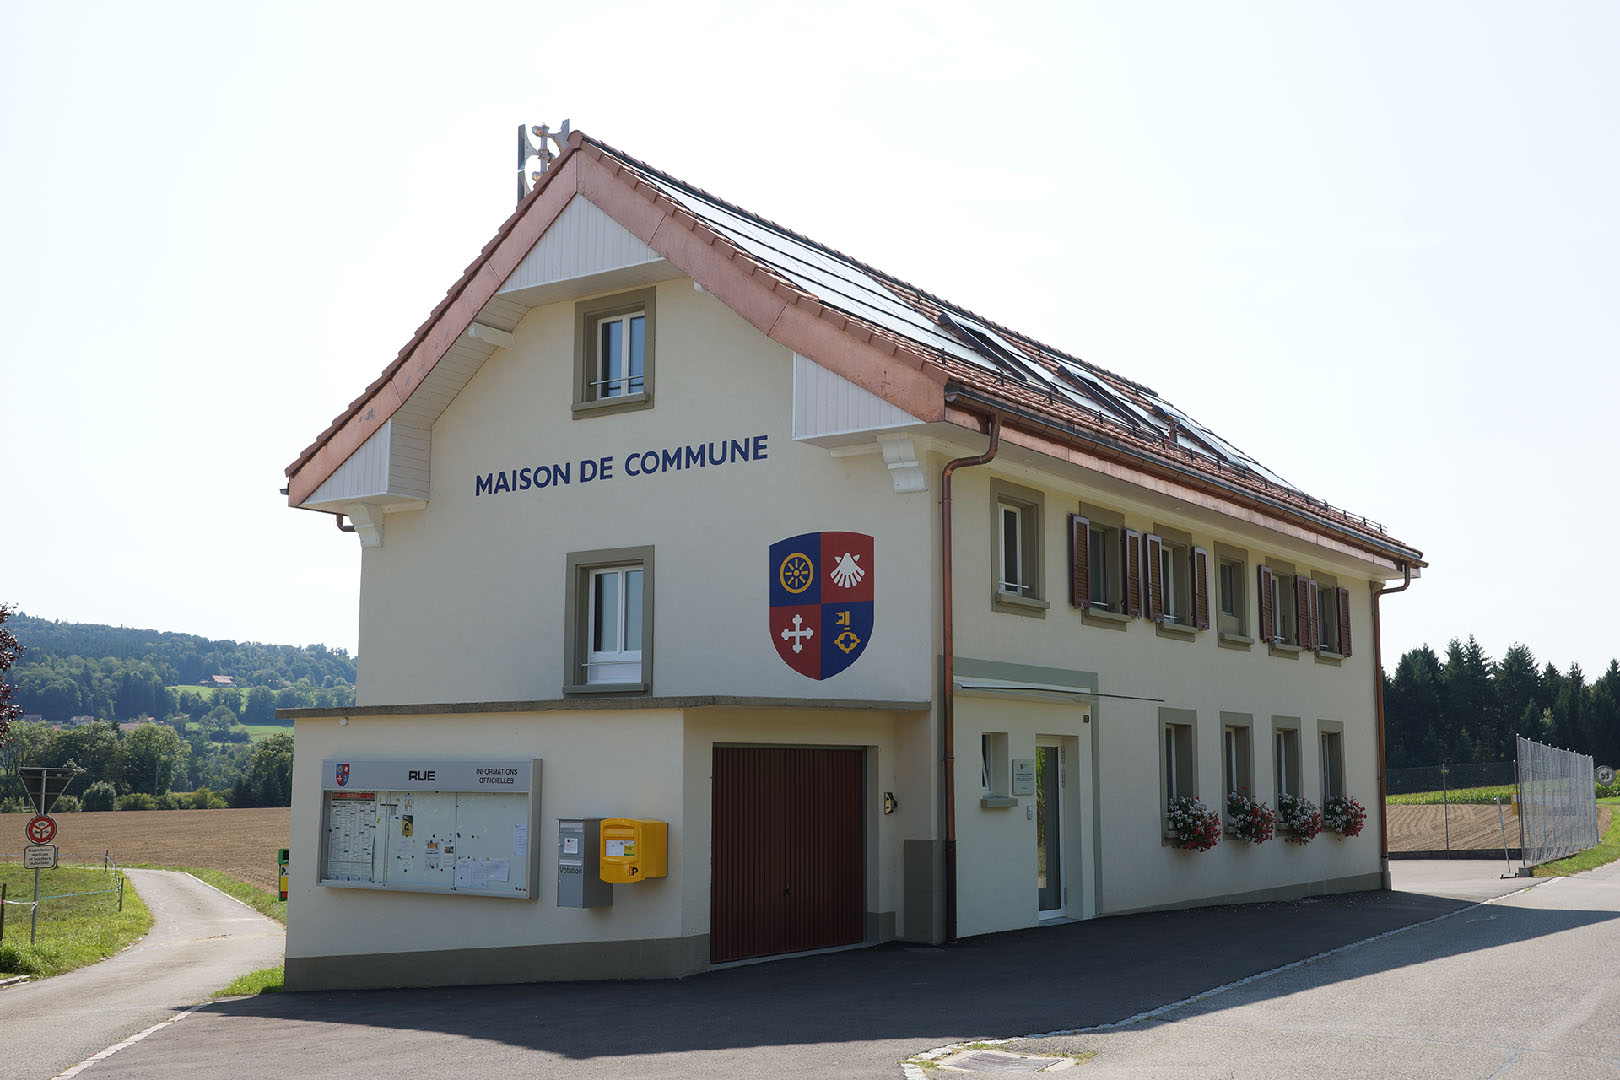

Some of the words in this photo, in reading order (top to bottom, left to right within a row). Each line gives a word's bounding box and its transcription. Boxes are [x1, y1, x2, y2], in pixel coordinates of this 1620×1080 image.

[475, 462, 571, 497] MAISON
[579, 456, 614, 483] DE
[624, 434, 769, 477] COMMUNE
[408, 770, 436, 781] RUE
[476, 768, 518, 776] INFORMATIONS
